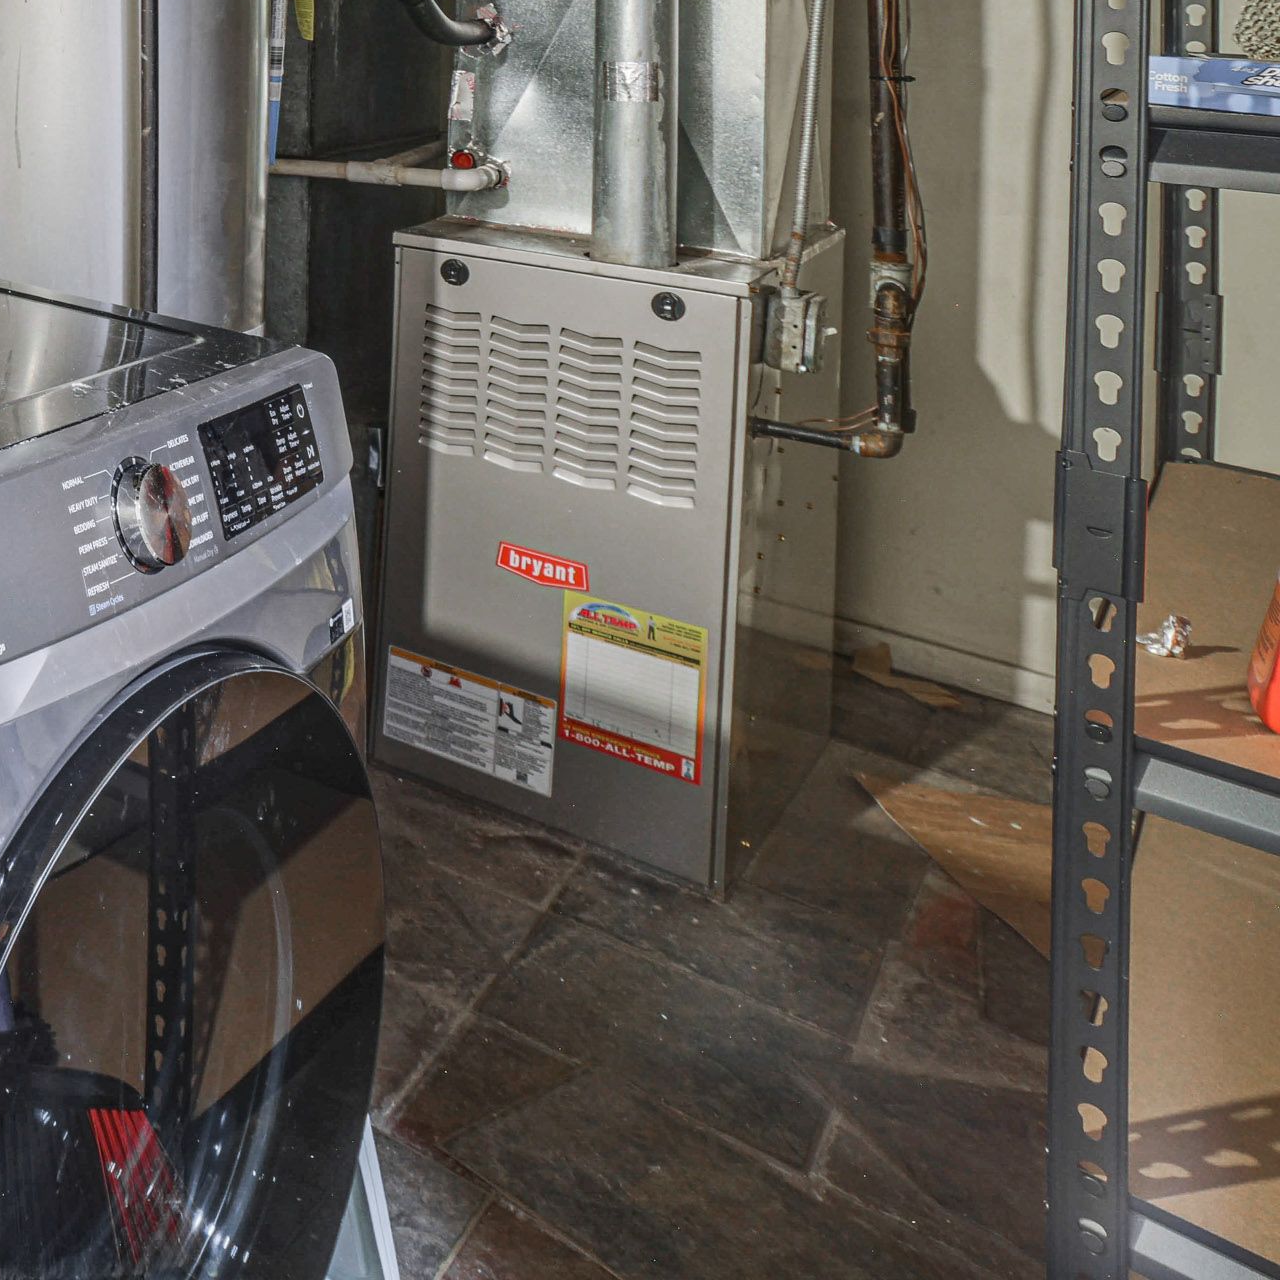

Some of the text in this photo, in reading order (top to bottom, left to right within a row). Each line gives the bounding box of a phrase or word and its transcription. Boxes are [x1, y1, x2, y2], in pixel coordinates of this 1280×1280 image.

[1154, 81, 1188, 93] Fresh
[166, 434, 189, 449] DELICATES
[61, 476, 84, 491] NORMAL
[67, 495, 98, 515] HEAVY DUTY
[73, 519, 96, 535] BEDDING
[78, 536, 109, 556] PERM PRESS
[83, 561, 99, 577] STEAM
[508, 549, 576, 585] bryant
[87, 580, 110, 597] REFRESH
[95, 593, 124, 613] Steam Cycles
[601, 614, 638, 630] TEMP
[564, 729, 676, 771] 1-800-ALL-TEMP
